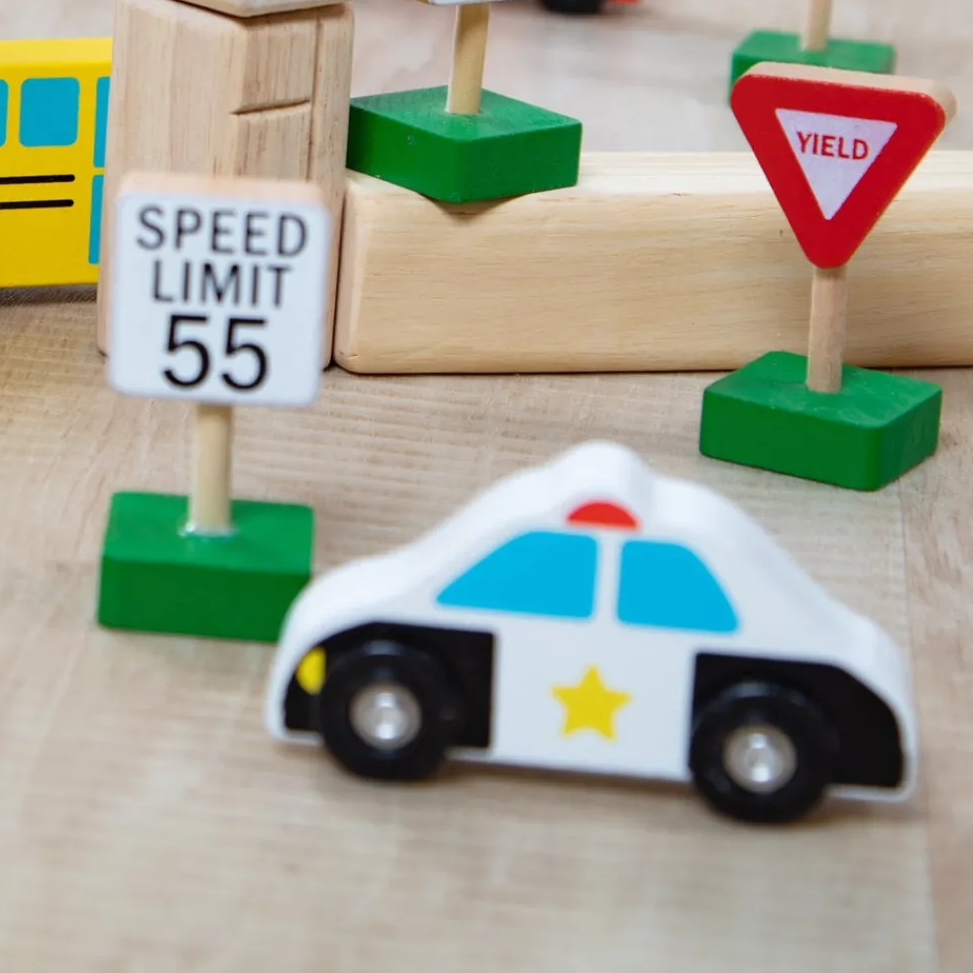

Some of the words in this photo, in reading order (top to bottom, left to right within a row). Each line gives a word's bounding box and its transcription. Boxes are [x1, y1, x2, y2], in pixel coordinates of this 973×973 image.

[797, 130, 869, 161] YIELD
[136, 205, 307, 257] SPEED
[152, 258, 293, 309] LIMIT
[161, 314, 269, 391] 55
